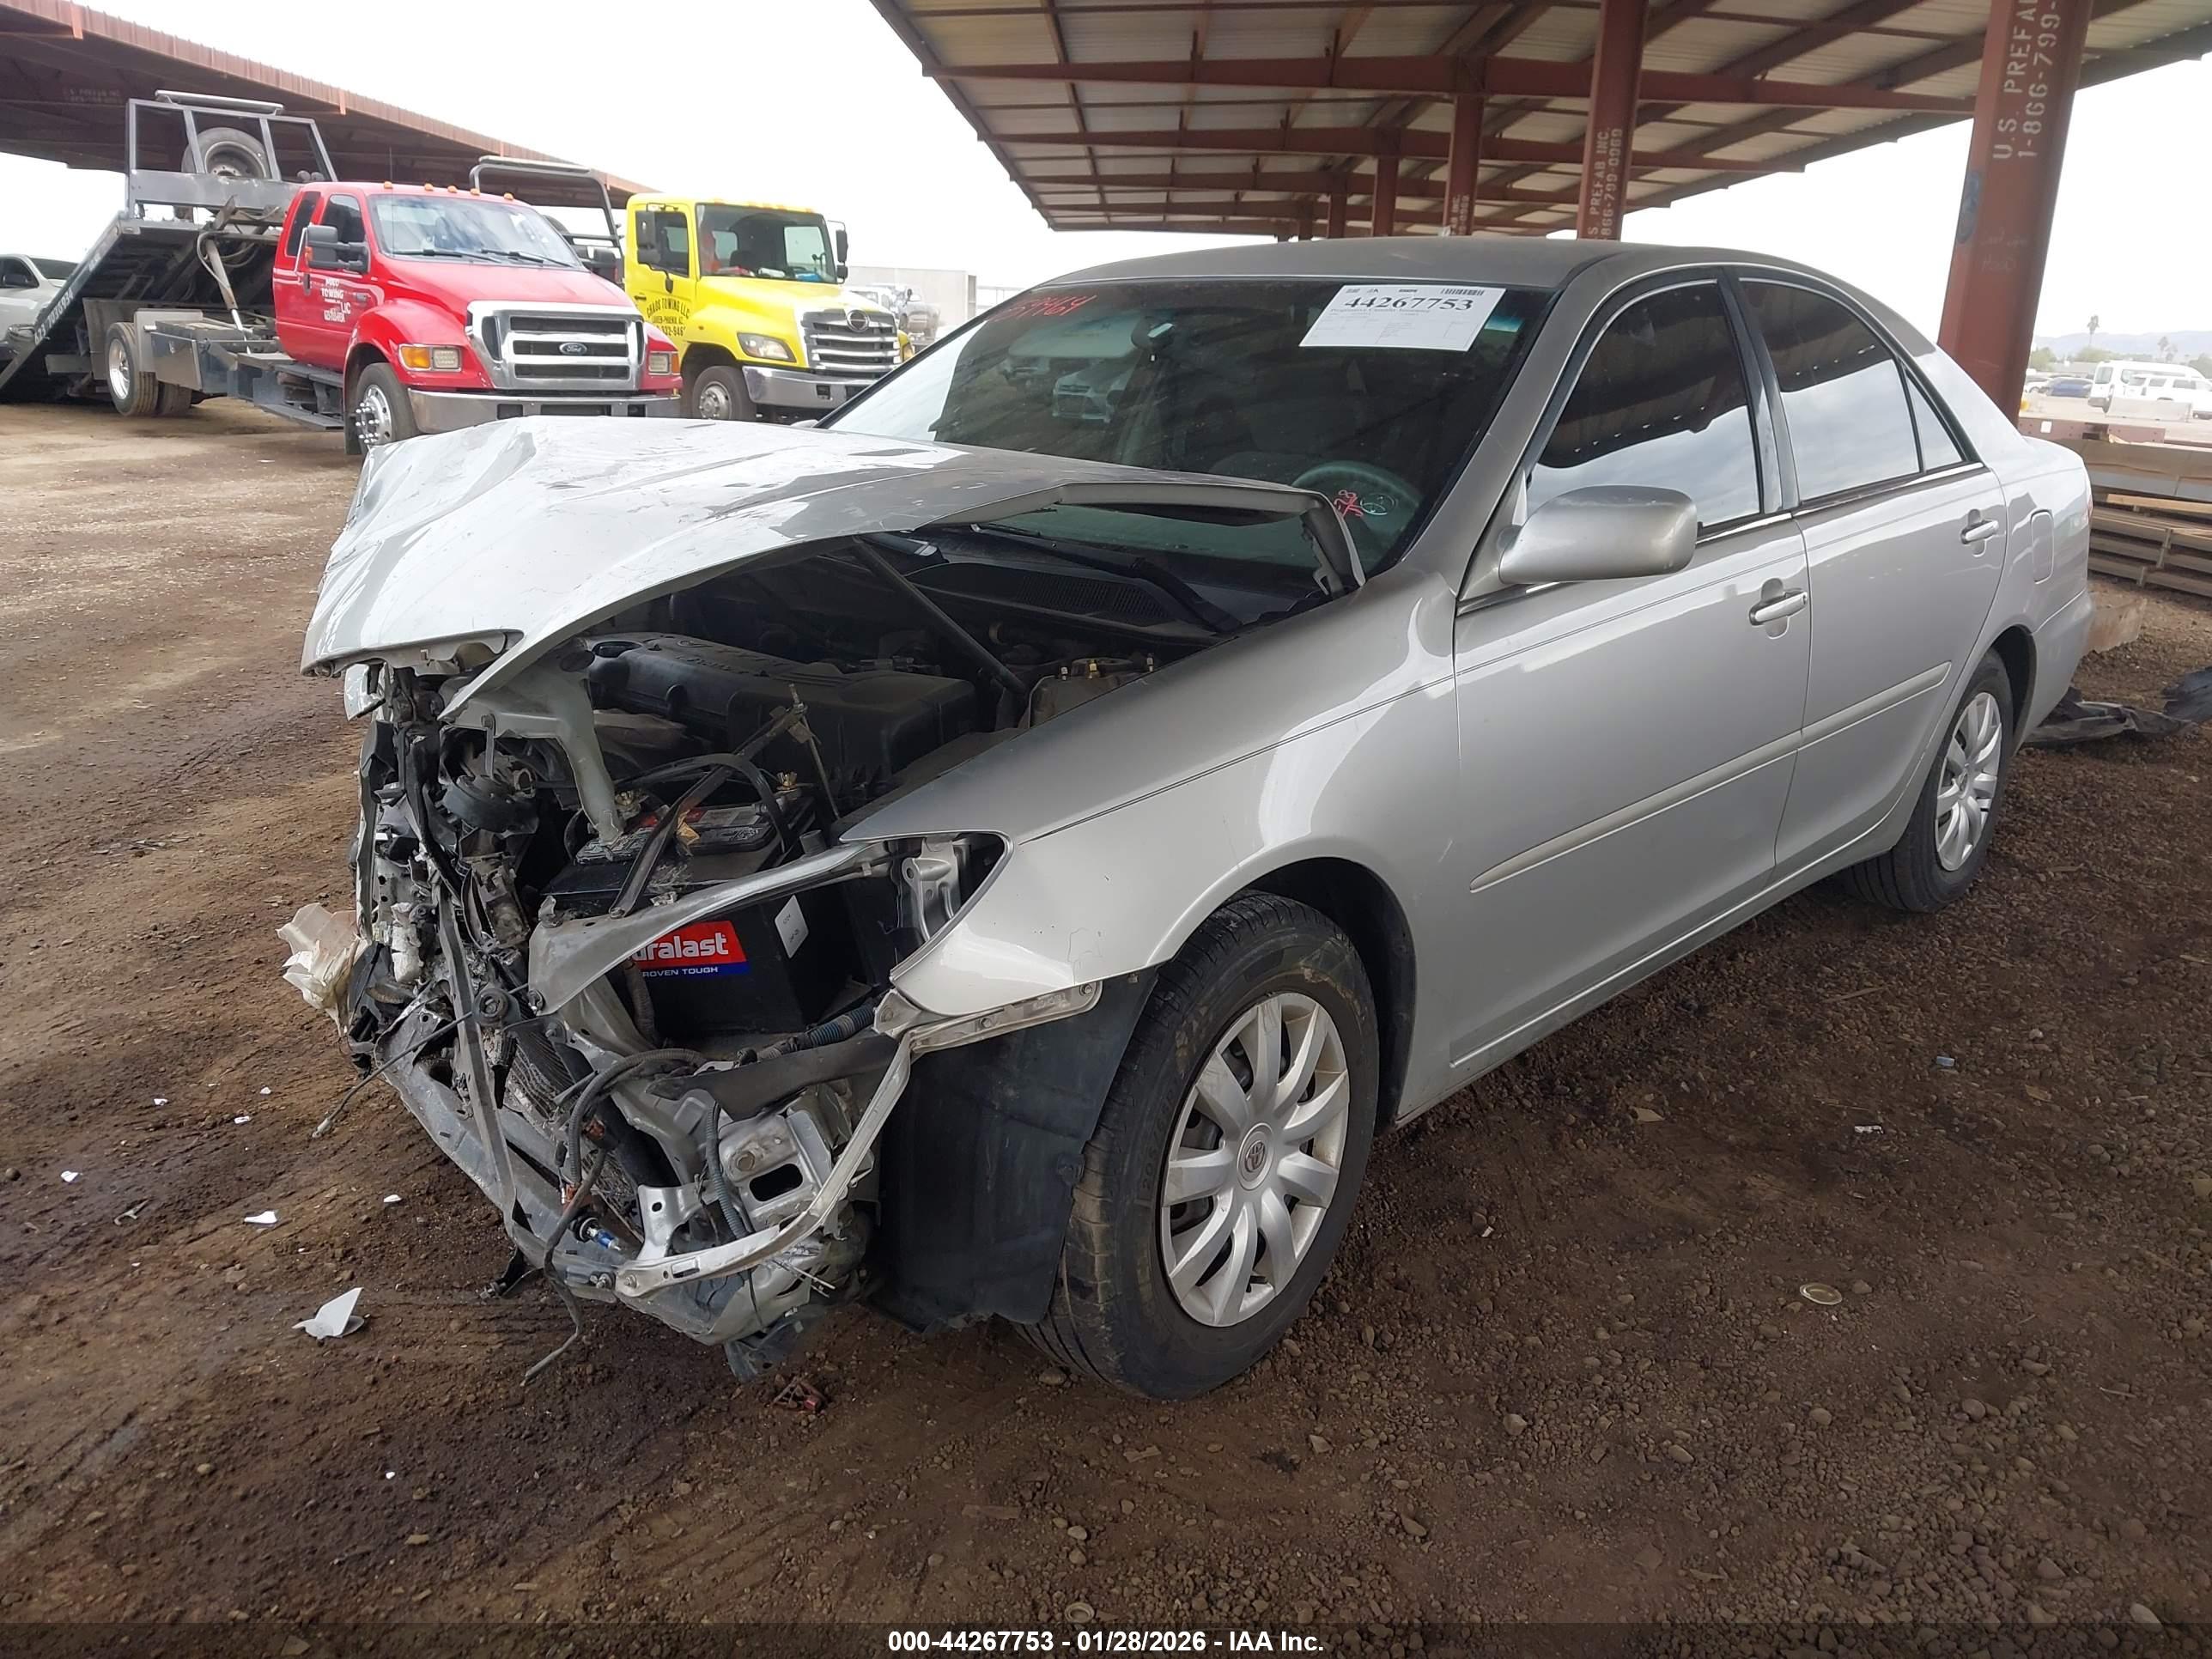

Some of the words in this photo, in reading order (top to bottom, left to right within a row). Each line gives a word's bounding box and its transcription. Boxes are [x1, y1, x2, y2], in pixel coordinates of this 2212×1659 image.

[1590, 161, 1607, 215] PREFAB
[662, 297, 679, 312] TOWING
[681, 302, 690, 319] LLC
[1345, 296, 1474, 311] 44267753
[633, 933, 729, 961] uralast
[683, 966, 719, 975] TOUGH
